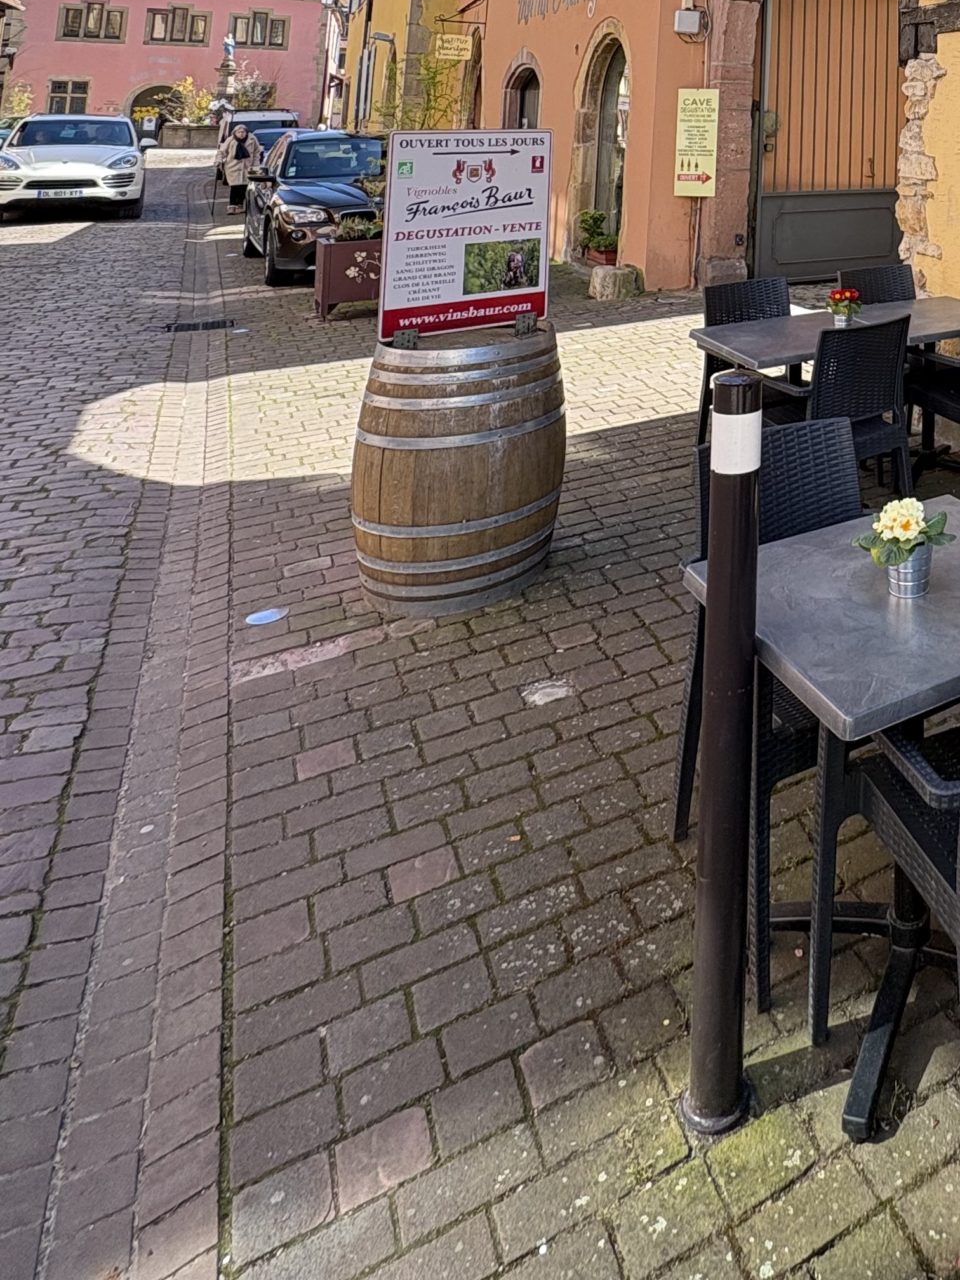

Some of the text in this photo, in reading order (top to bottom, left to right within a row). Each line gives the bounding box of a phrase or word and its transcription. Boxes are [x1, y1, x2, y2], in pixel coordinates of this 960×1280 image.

[683, 98, 712, 106] CAVE
[399, 137, 545, 149] OUVERT TOUS LES JOURS
[406, 185, 458, 199] Vignobles
[404, 185, 536, 223] François Baur
[395, 225, 492, 241] DEGUSTATION
[502, 221, 542, 233] VENTE
[399, 304, 531, 327] www.vinsbaur.com
